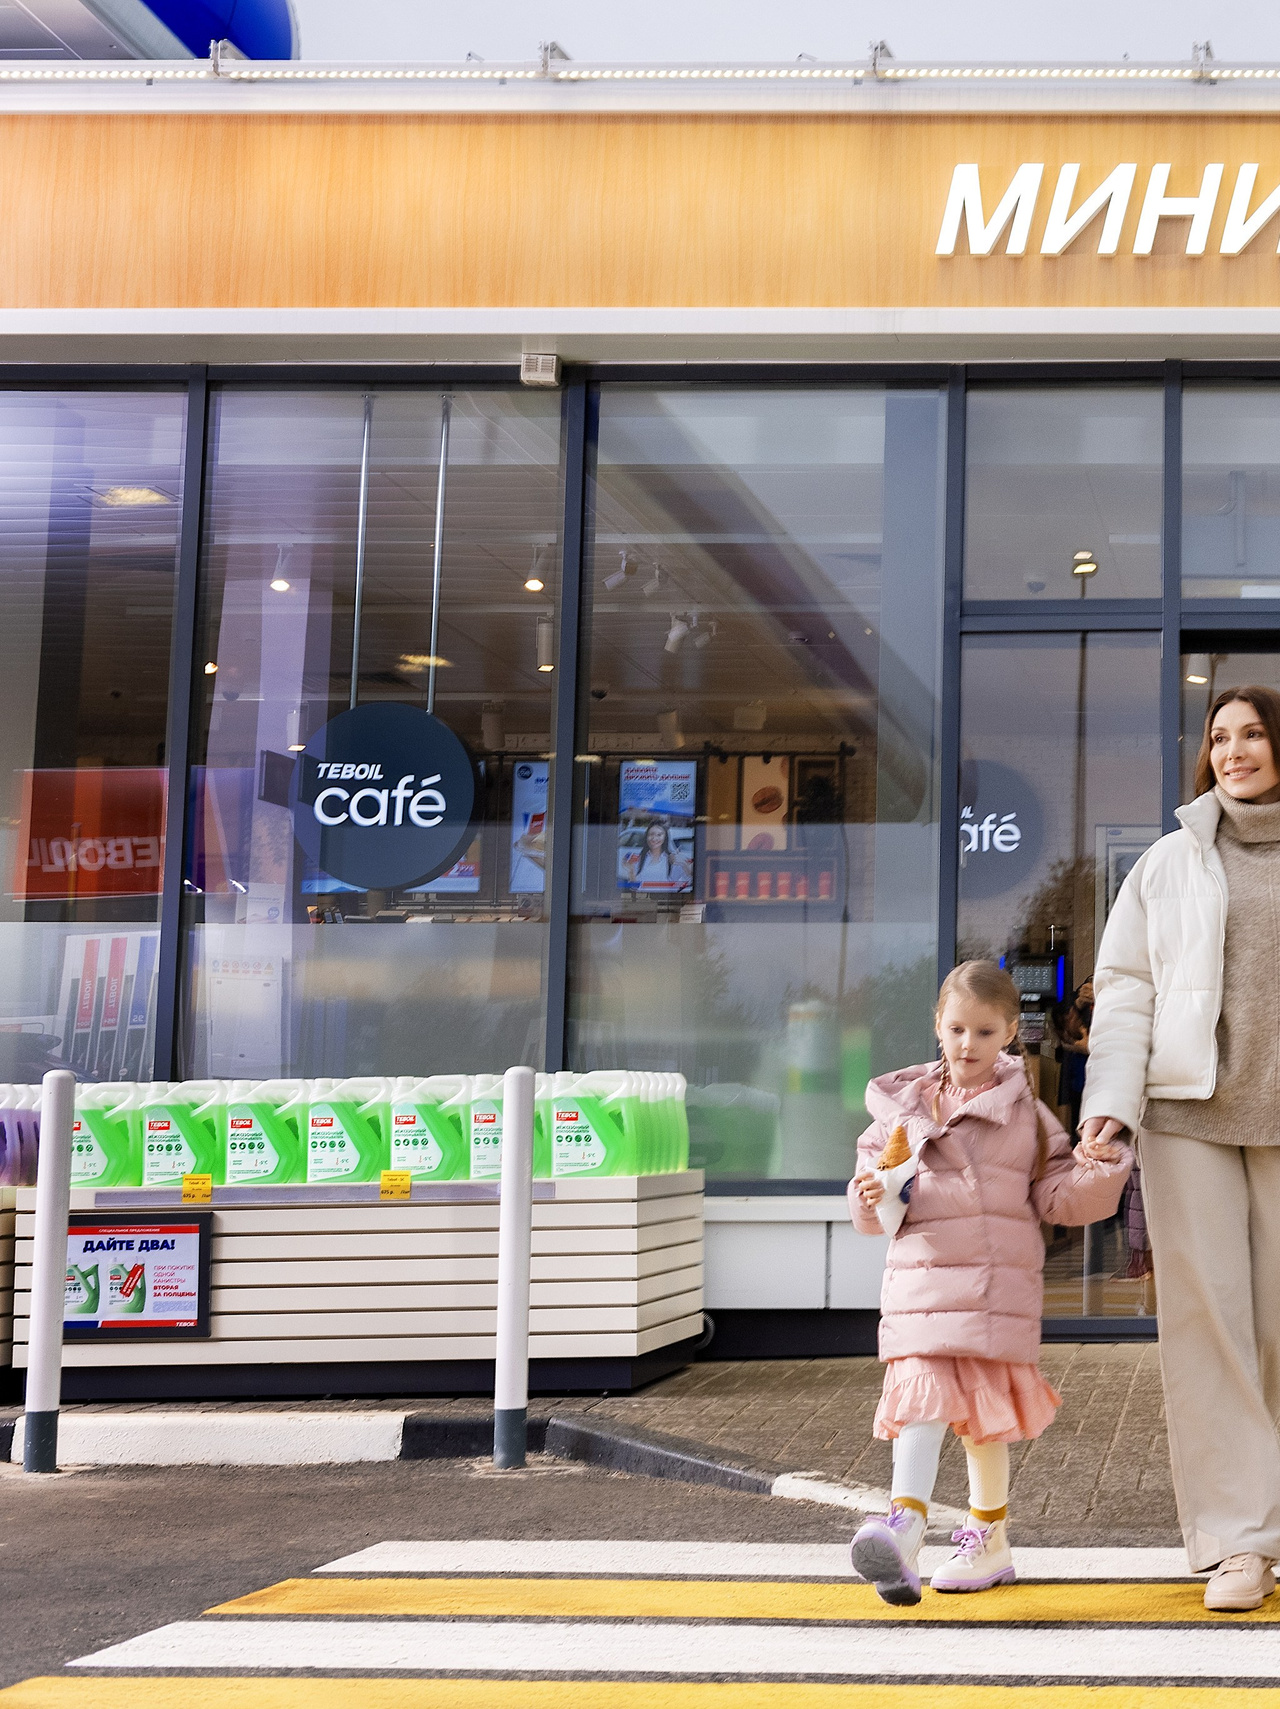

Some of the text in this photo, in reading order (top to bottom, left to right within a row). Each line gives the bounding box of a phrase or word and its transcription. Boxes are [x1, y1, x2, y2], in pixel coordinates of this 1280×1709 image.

[316, 762, 384, 780] TEBOIL
[313, 773, 447, 828] café
[960, 812, 1022, 853] afé
[83, 1237, 176, 1253] ДАЙТЕ ДВА!
